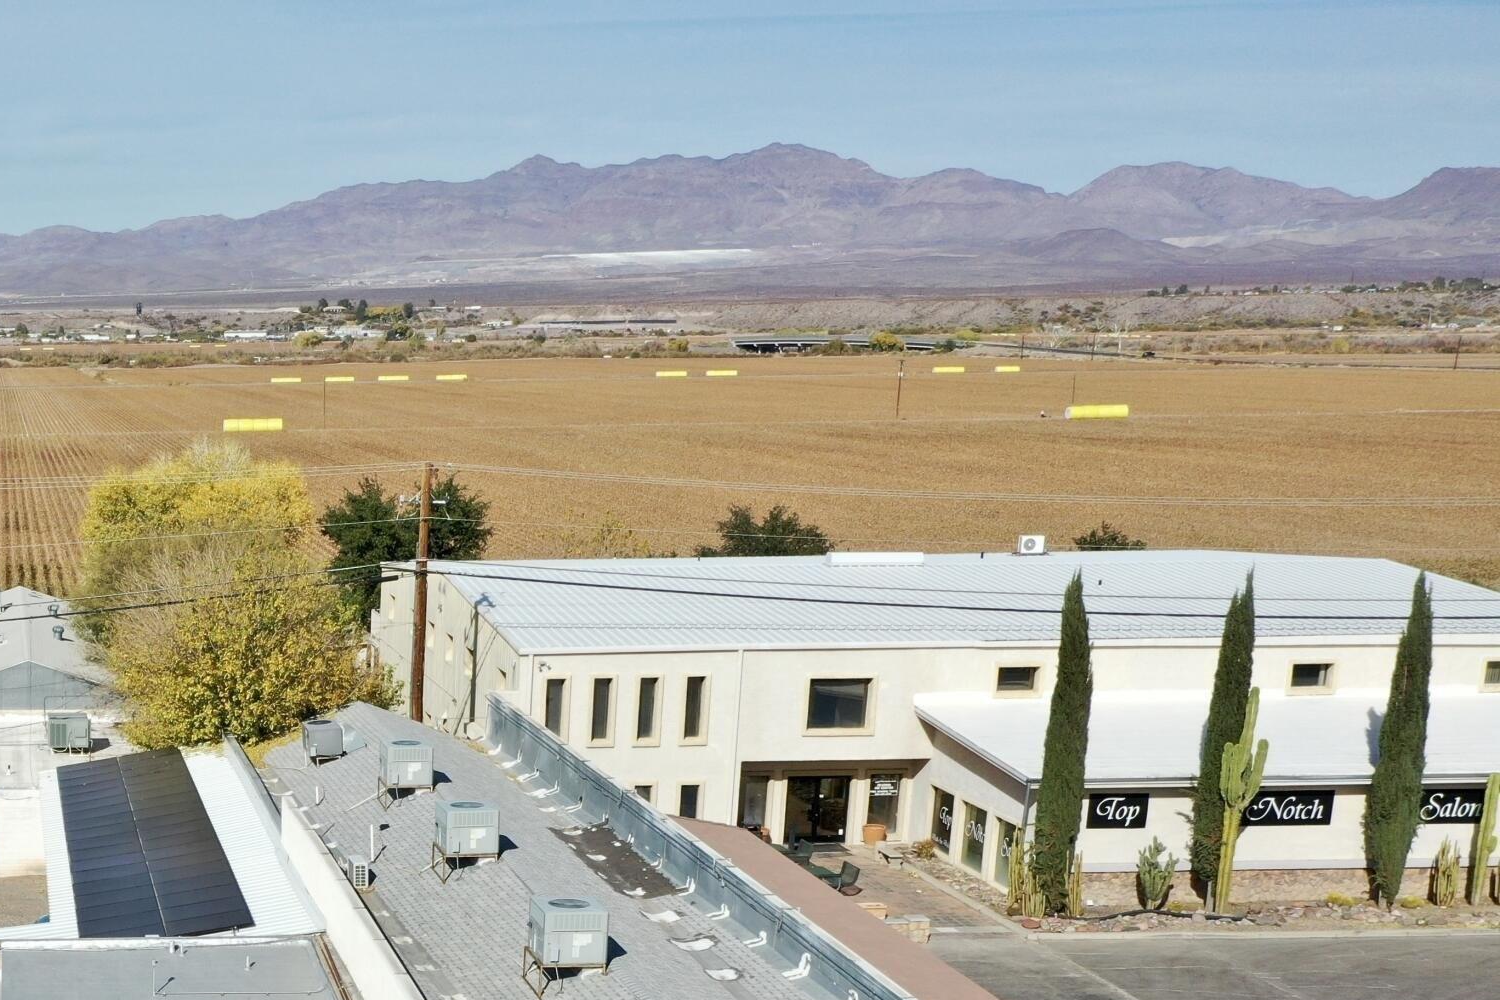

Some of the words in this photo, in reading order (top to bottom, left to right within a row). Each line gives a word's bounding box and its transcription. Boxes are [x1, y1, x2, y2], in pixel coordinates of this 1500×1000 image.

[1096, 797, 1140, 827] Top
[1246, 796, 1324, 821] Notch
[1420, 793, 1482, 820] Salon
